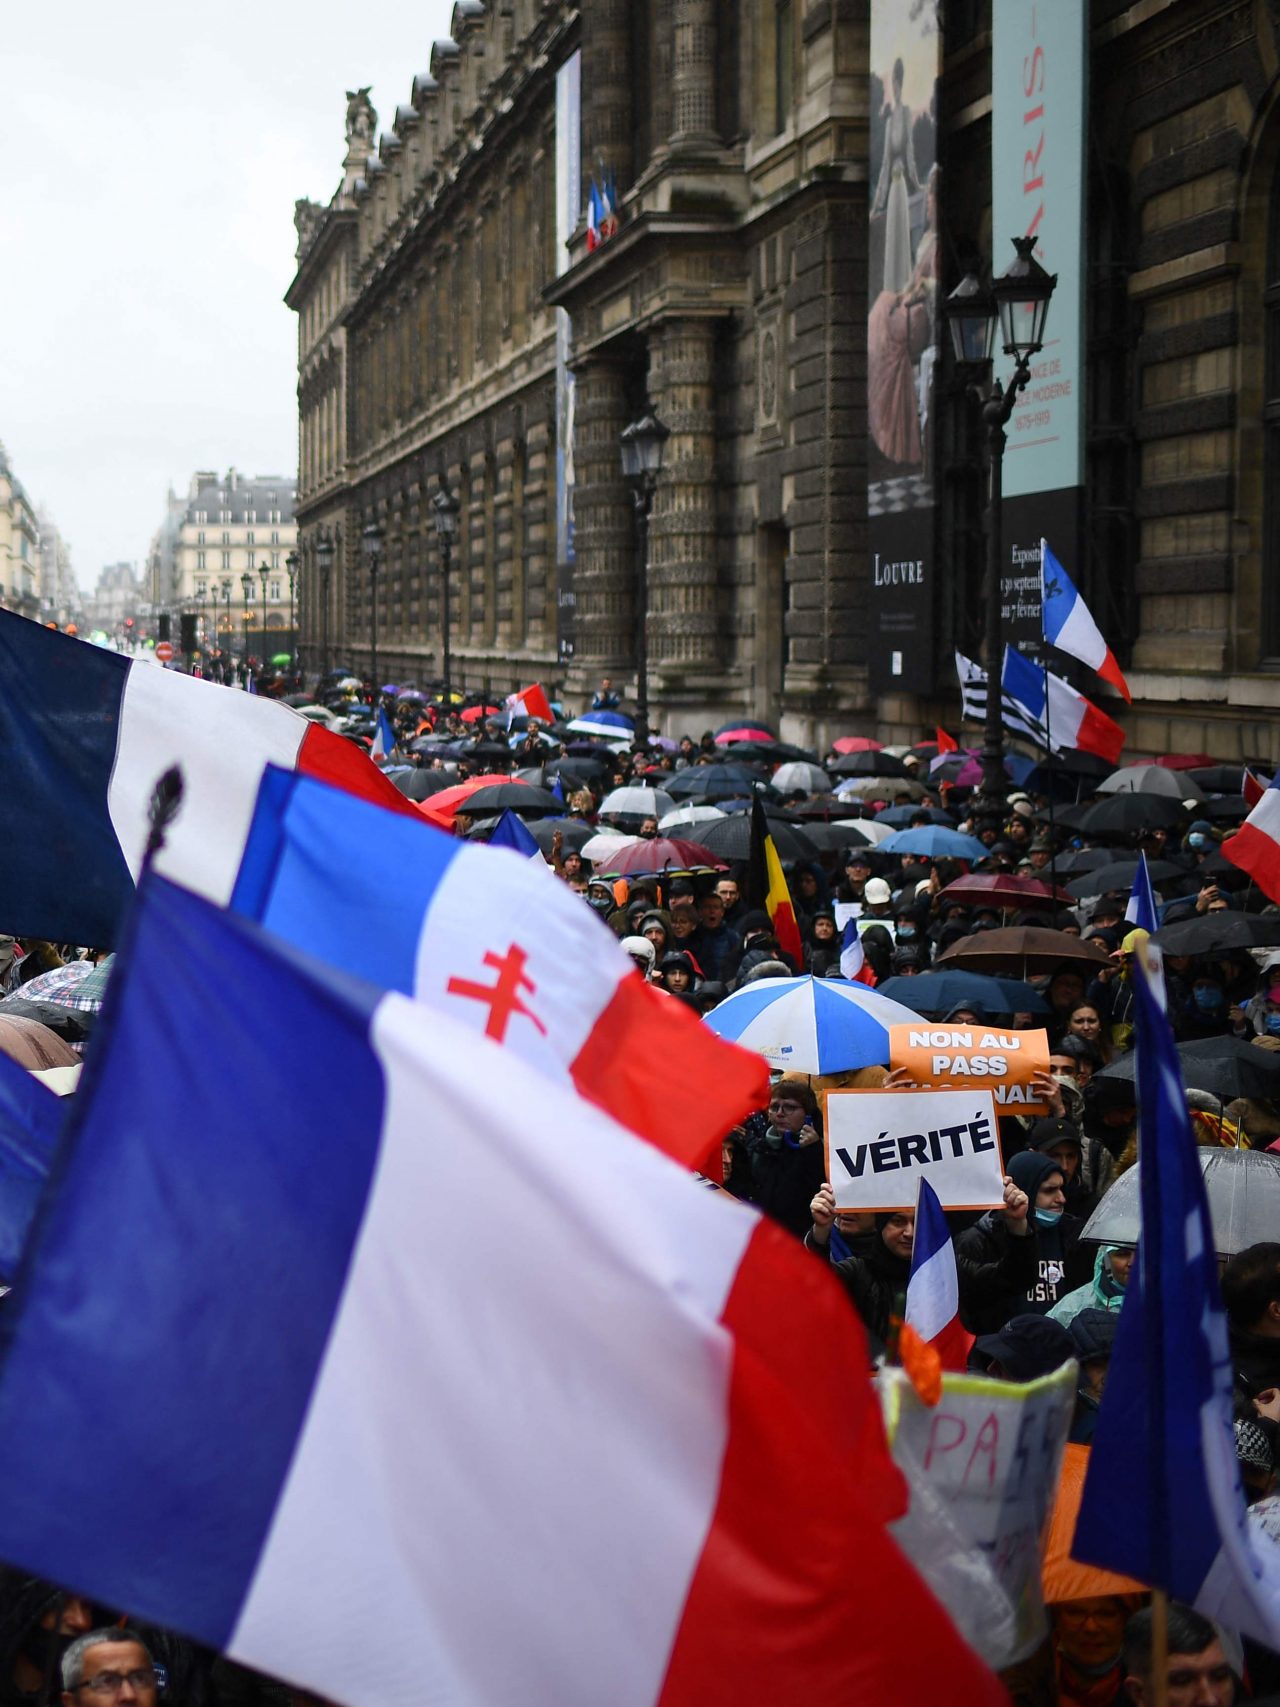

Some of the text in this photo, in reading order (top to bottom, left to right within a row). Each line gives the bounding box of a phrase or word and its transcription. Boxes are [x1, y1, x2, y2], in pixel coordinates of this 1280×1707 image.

[1012, 542, 1042, 569] Expositi
[875, 554, 924, 586] LOUVRE
[1014, 569, 1042, 596] septemb
[909, 1031, 1020, 1049] NON AU
[932, 1055, 1008, 1076] PASS
[835, 1111, 995, 1178] VÉRITÉ
